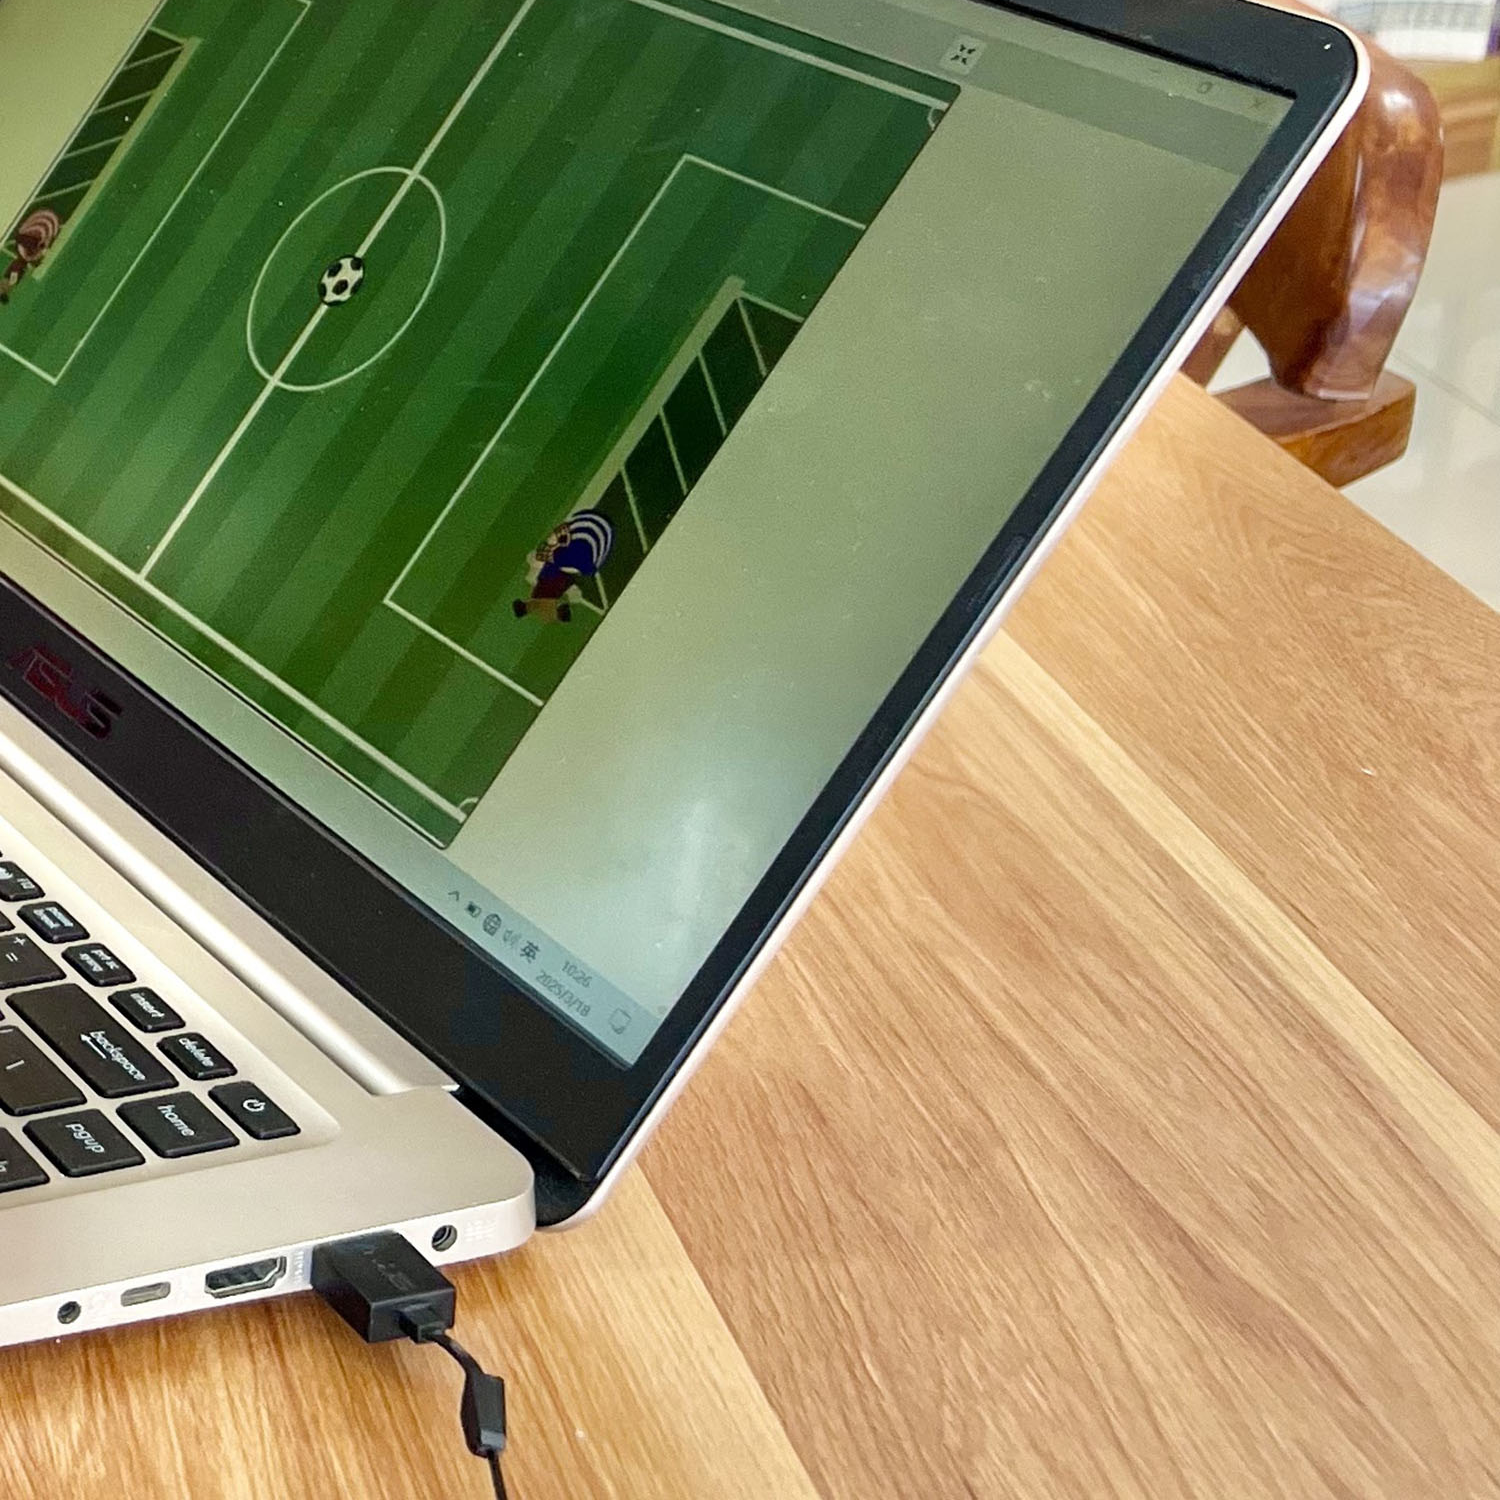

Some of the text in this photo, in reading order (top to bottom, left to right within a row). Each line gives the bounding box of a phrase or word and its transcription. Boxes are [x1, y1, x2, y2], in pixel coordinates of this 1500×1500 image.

[4, 647, 124, 741] ASUS
[519, 940, 541, 963] 英
[561, 960, 593, 989] 10:26
[130, 992, 165, 1019] insert
[89, 1030, 147, 1082] backspace
[178, 1036, 215, 1068] delete
[157, 1103, 195, 1137] home
[65, 1122, 105, 1154] pgup
